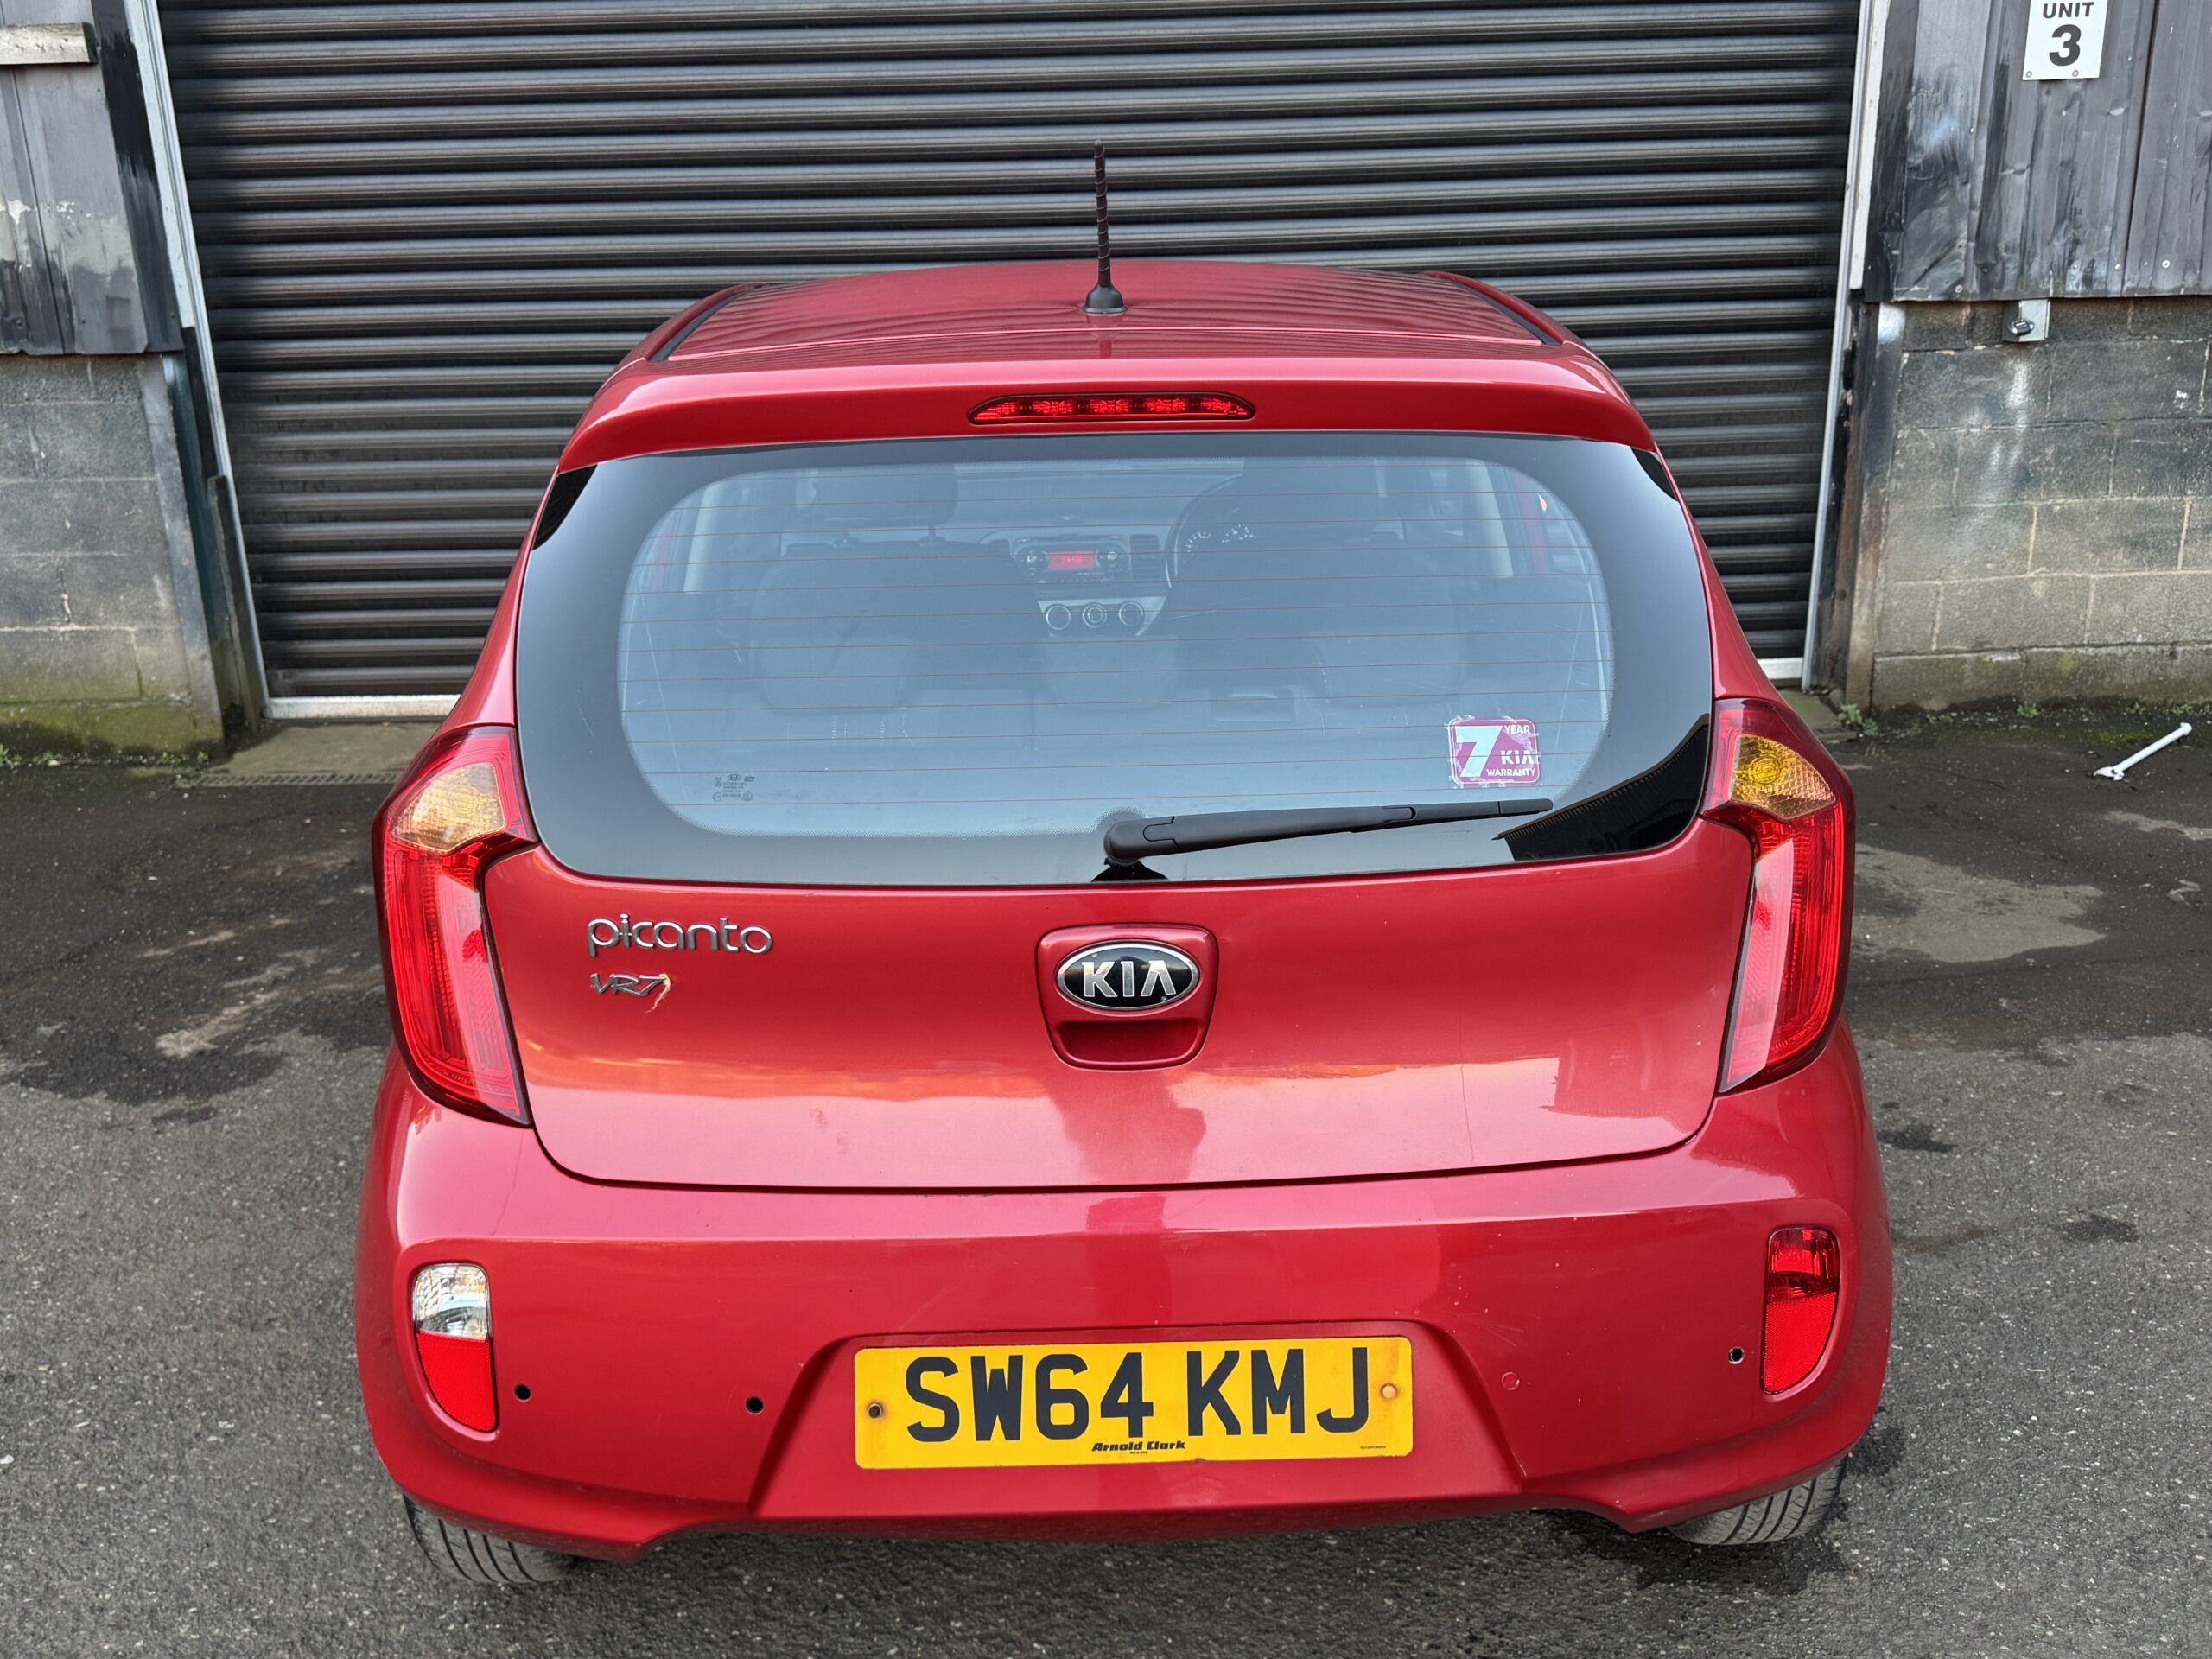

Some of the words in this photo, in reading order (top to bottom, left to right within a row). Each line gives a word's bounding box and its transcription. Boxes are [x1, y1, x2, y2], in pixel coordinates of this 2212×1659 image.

[2043, 2, 2094, 19] UNIT
[2049, 24, 2082, 67] 3
[1504, 725, 1531, 734] YEAR
[1454, 726, 1503, 777] 7
[1500, 750, 1535, 765] KIA
[1486, 768, 1535, 777] WARRANTY
[588, 913, 772, 958] picanto
[589, 973, 669, 996] VR7
[1082, 960, 1177, 997] KIA
[906, 1351, 1154, 1442] SW64
[1186, 1347, 1369, 1436] KMJ
[1092, 1441, 1143, 1452] Arnold
[1147, 1440, 1185, 1450] Clark
